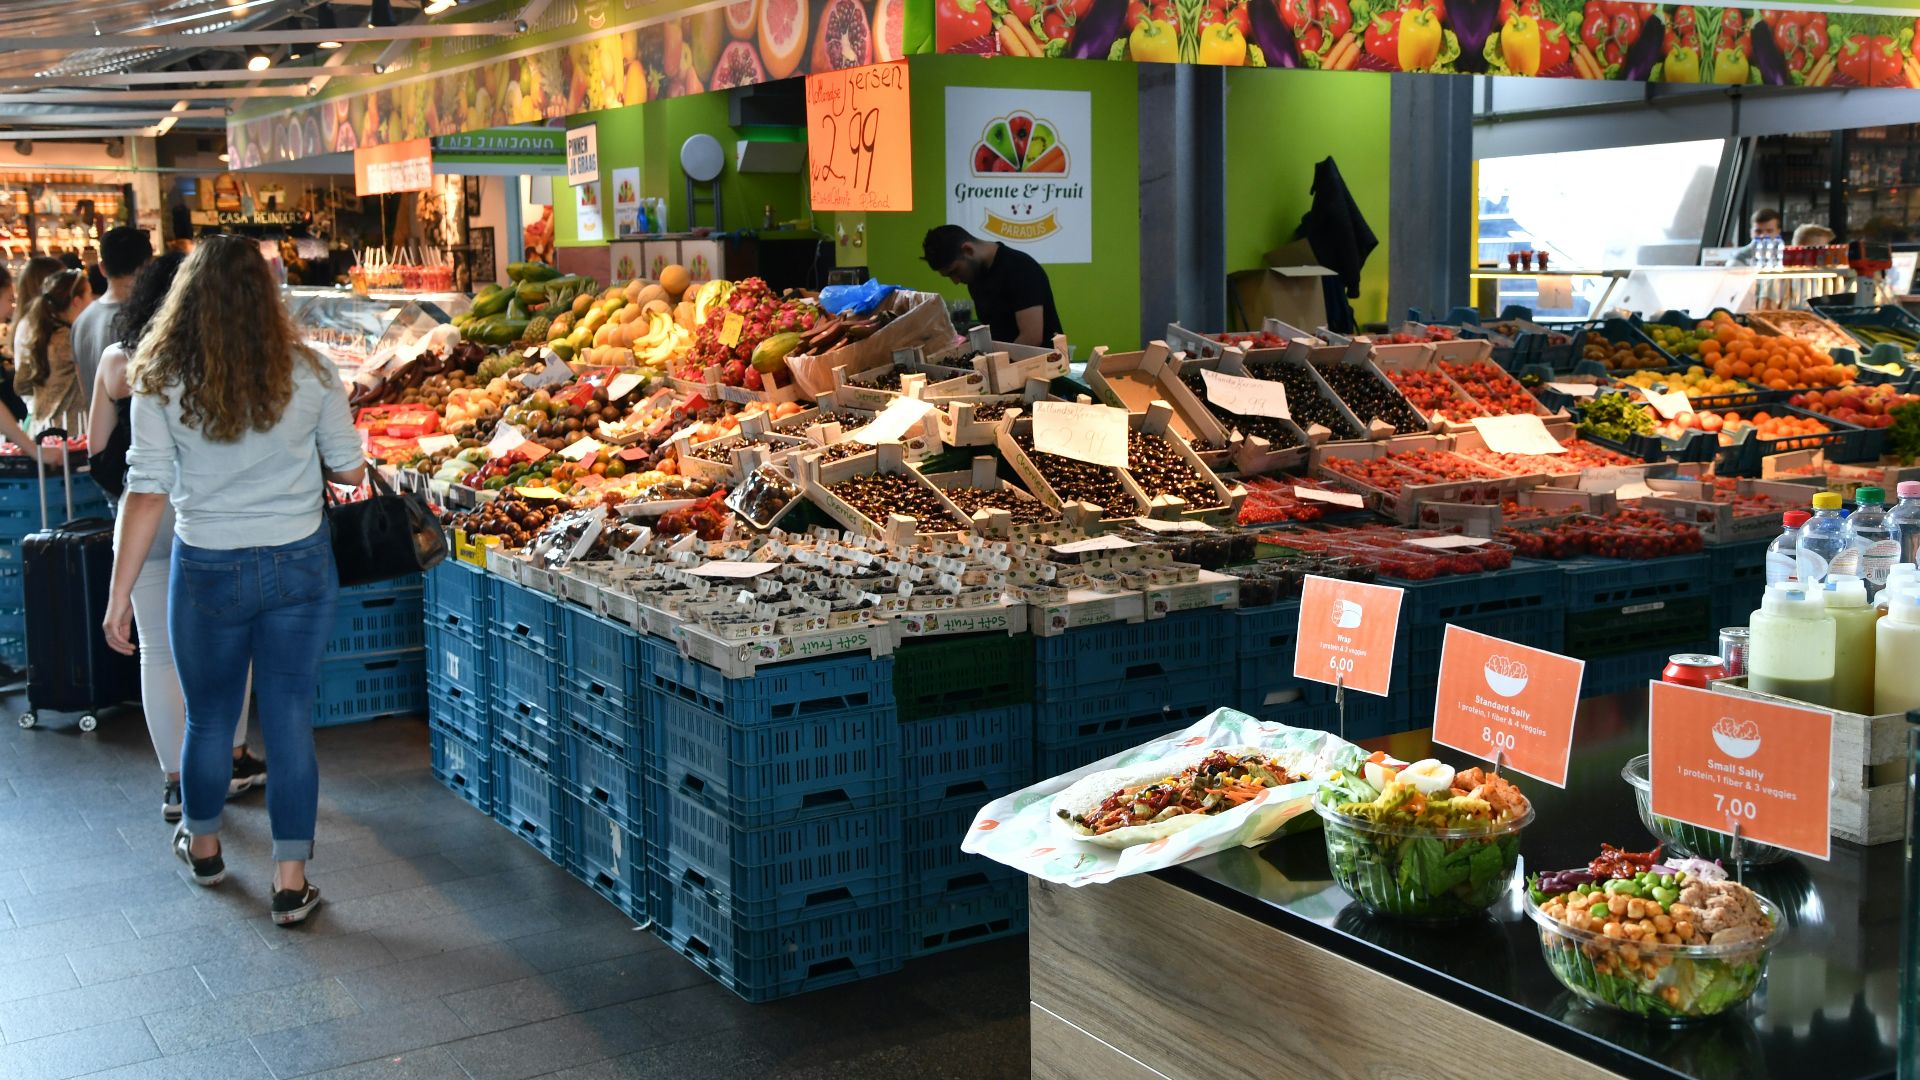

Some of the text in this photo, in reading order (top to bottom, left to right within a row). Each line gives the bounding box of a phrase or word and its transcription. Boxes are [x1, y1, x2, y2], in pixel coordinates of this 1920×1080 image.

[570, 158, 577, 176] JA
[954, 182, 1084, 203] Groente & Fruit
[218, 212, 249, 225] CASA
[1000, 222, 1047, 238] PARADIJS
[944, 615, 1007, 632] Soft Fruit
[799, 634, 868, 655] Soft Fruit
[1337, 634, 1352, 644] Wrap
[1329, 656, 1354, 672] 6,00
[1475, 695, 1531, 721] Standard Sally
[1457, 701, 1461, 709] 1
[1461, 704, 1486, 718] protein,
[1491, 712, 1508, 724] fiber
[1514, 720, 1520, 728] 4
[1520, 723, 1547, 737] veggies
[1482, 726, 1516, 750] 8,00
[1707, 759, 1765, 781] Small Sally
[1677, 765, 1797, 801] 1 protein, 1 fiber & 3 veggies
[1713, 793, 1757, 820] 7,00
